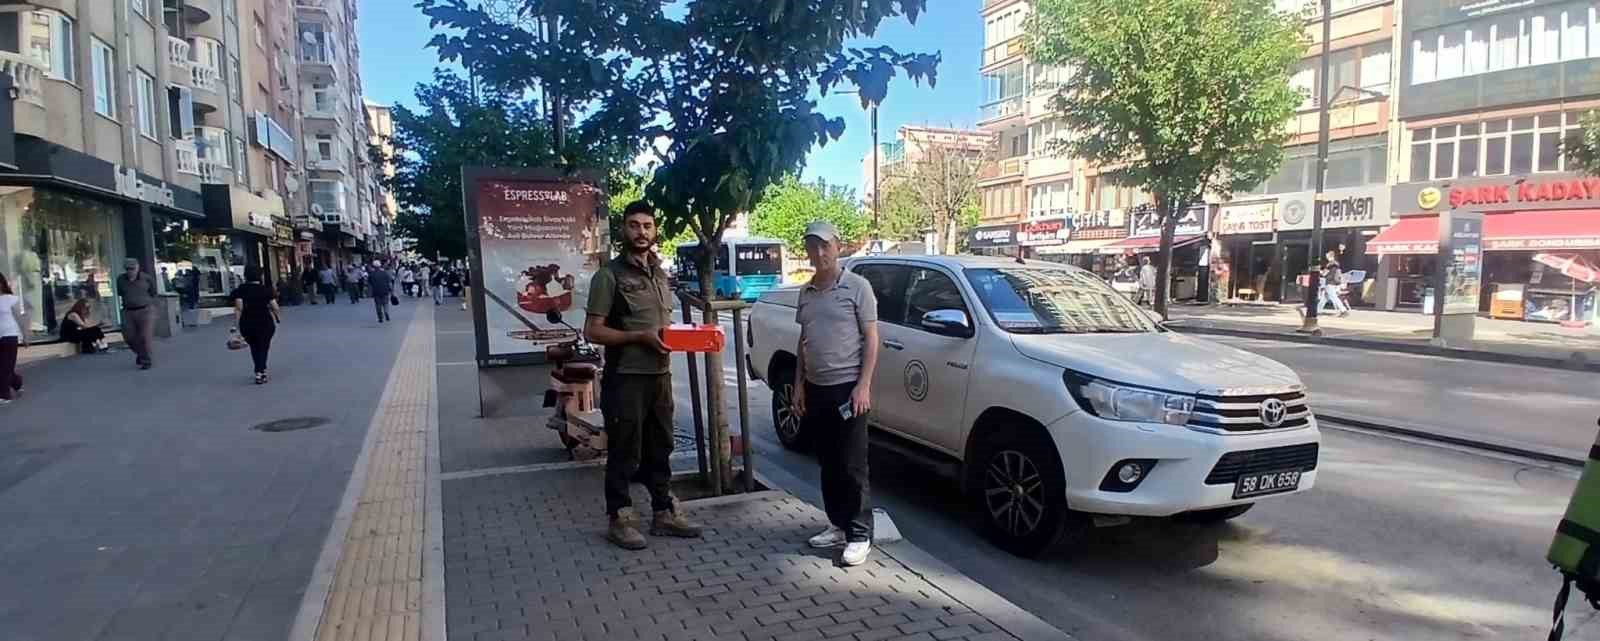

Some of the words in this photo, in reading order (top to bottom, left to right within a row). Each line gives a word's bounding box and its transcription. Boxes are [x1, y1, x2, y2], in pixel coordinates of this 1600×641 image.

[504, 189, 568, 201] ESPRESSOLAB
[1449, 183, 1510, 209] ŞARK
[1321, 195, 1374, 221] manken
[1242, 477, 1257, 492] 58
[1259, 474, 1278, 490] DK
[1277, 471, 1299, 488] 658
